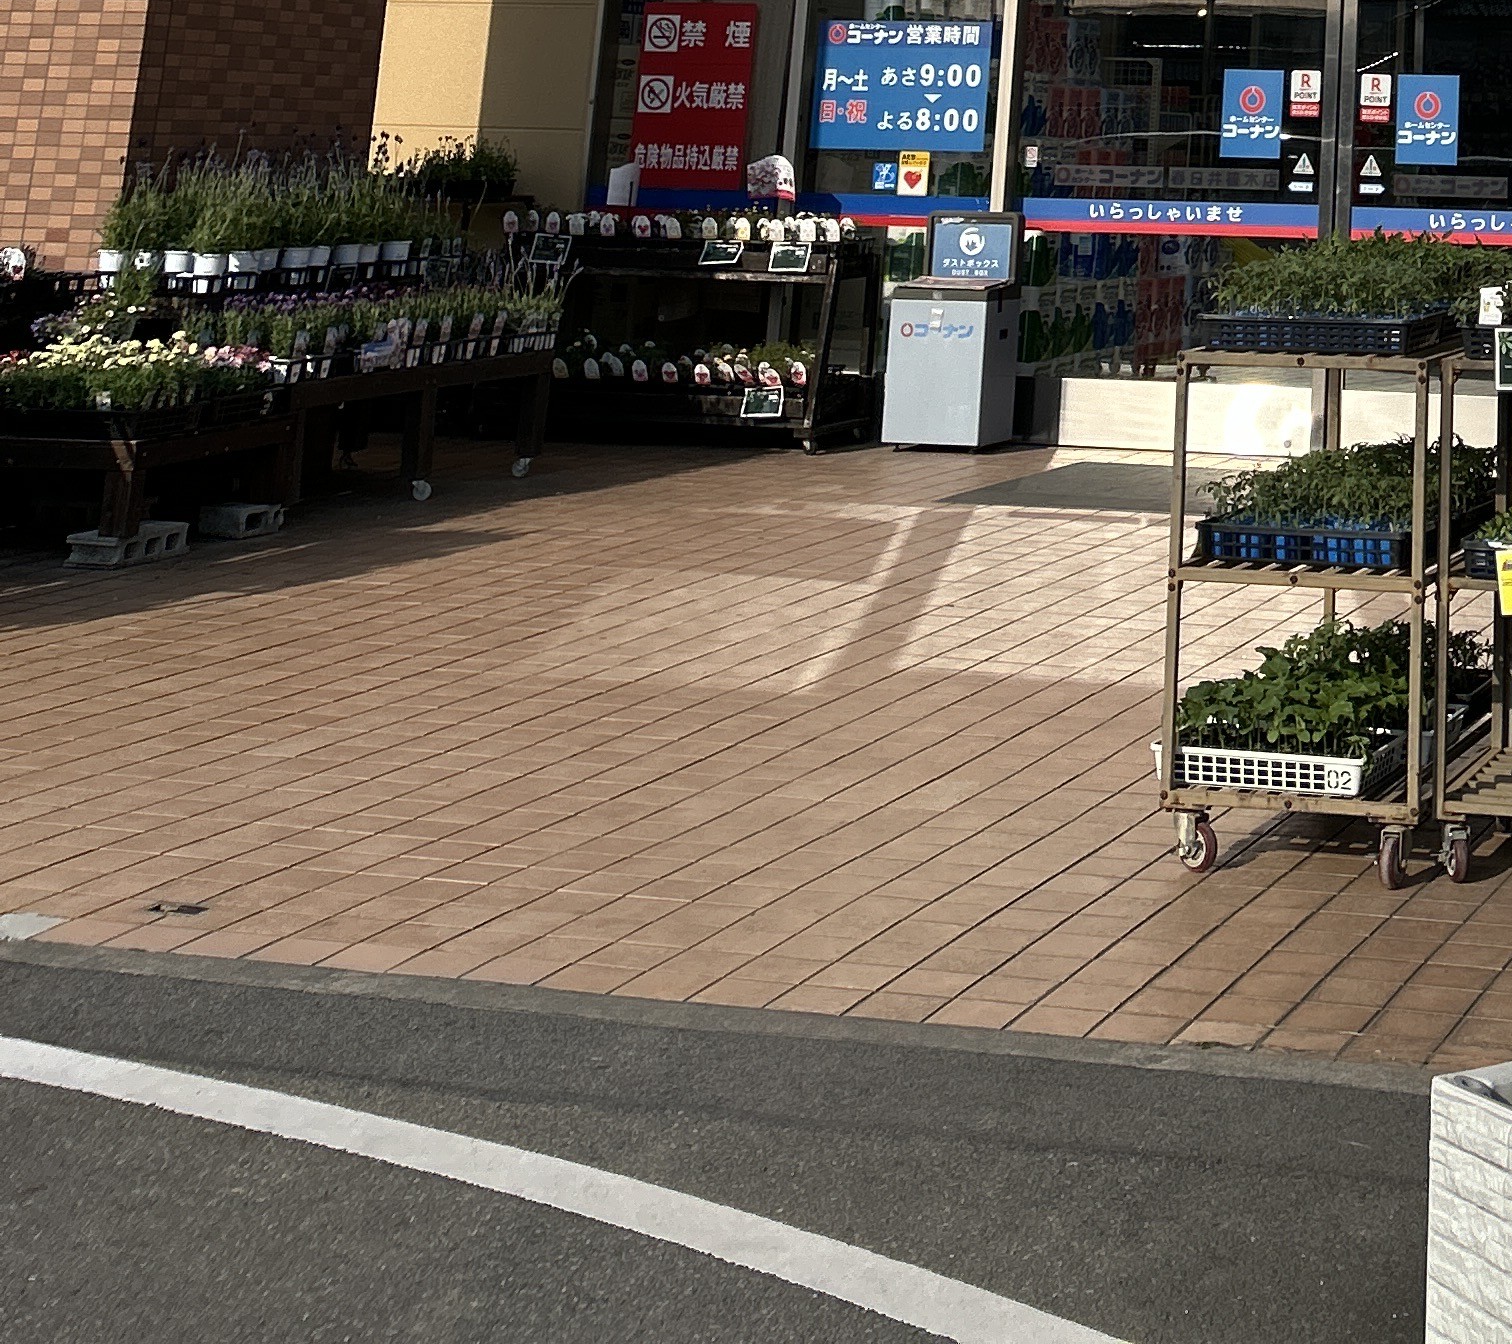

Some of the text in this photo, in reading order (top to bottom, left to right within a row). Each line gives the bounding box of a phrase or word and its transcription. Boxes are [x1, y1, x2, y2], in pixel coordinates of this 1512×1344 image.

[681, 20, 752, 48] 禁煙
[847, 25, 981, 45] コーナン 営業時間
[1301, 74, 1311, 87] R
[1371, 78, 1381, 91] R
[674, 81, 746, 110] 火気厳禁
[1293, 92, 1318, 100] POINT
[1363, 95, 1388, 103] POINT
[1222, 124, 1281, 140] コーナン
[1397, 130, 1457, 146] コーナン
[1100, 169, 1164, 185] コーナン
[1089, 202, 1244, 223] いらっしゃいませ
[942, 258, 999, 268] ダストボックス
[1327, 770, 1352, 790] 02
